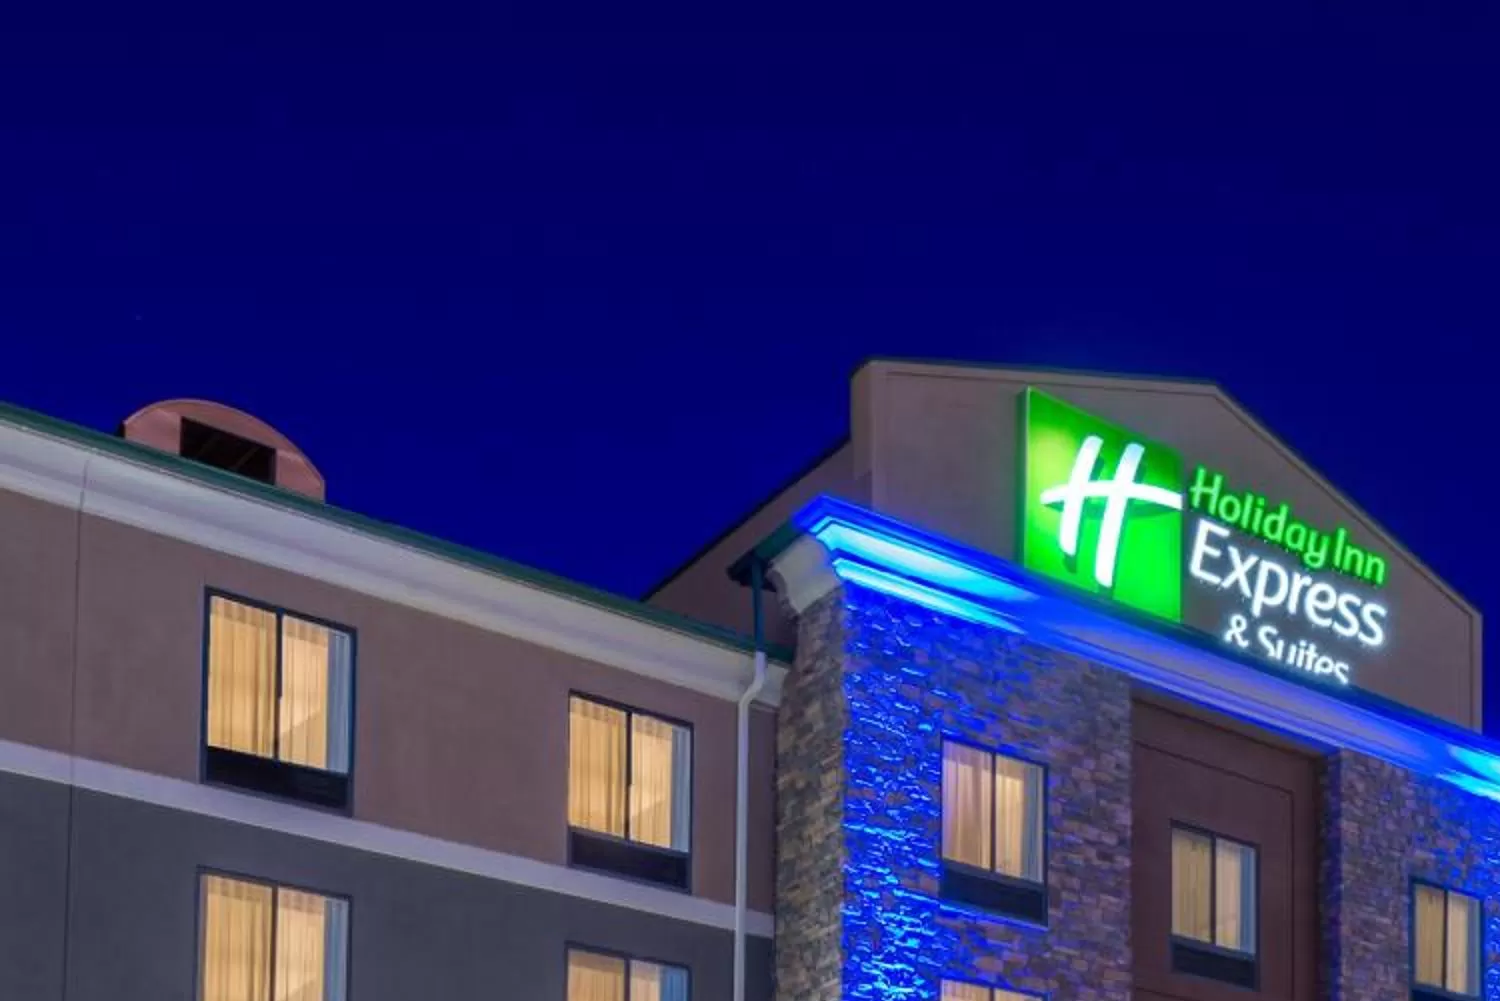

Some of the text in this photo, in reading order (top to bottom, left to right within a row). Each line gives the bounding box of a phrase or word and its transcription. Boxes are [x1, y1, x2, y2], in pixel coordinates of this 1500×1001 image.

[1189, 518, 1387, 646] Express
[1190, 466, 1385, 584] Holiday Inn
[1224, 613, 1249, 648] &
